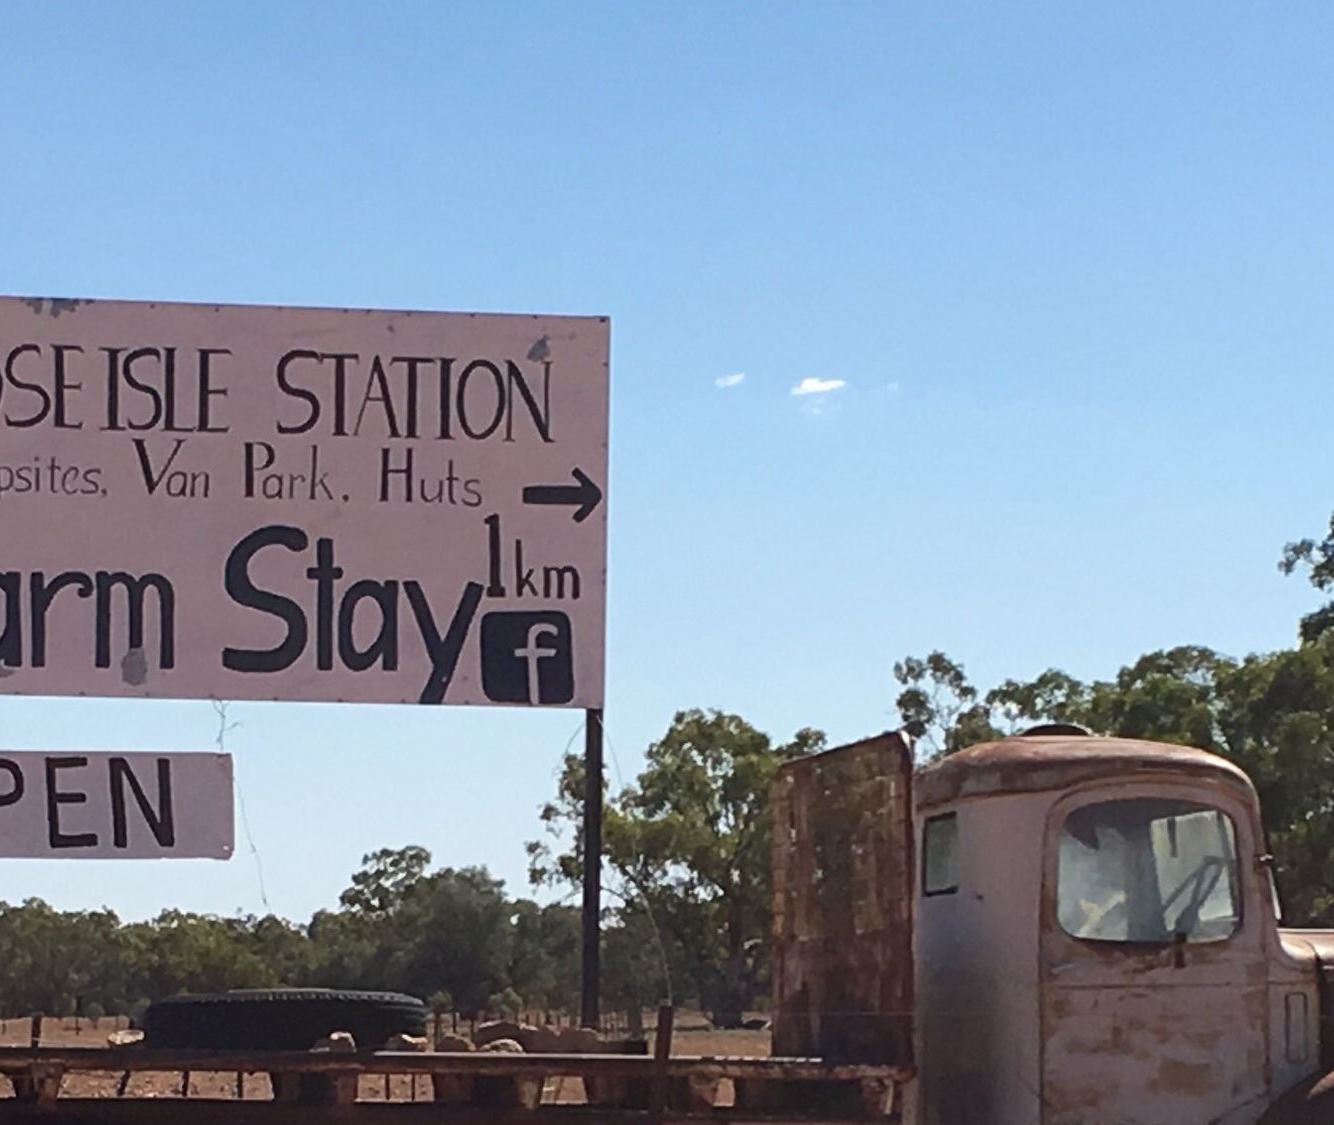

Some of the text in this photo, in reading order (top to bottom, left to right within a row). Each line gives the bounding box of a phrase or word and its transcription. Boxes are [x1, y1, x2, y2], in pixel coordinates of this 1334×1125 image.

[99, 346, 233, 434] ISLE
[276, 349, 556, 443] STATION
[132, 438, 211, 498] Van
[378, 447, 483, 508] Huts
[222, 525, 485, 705] Stay
